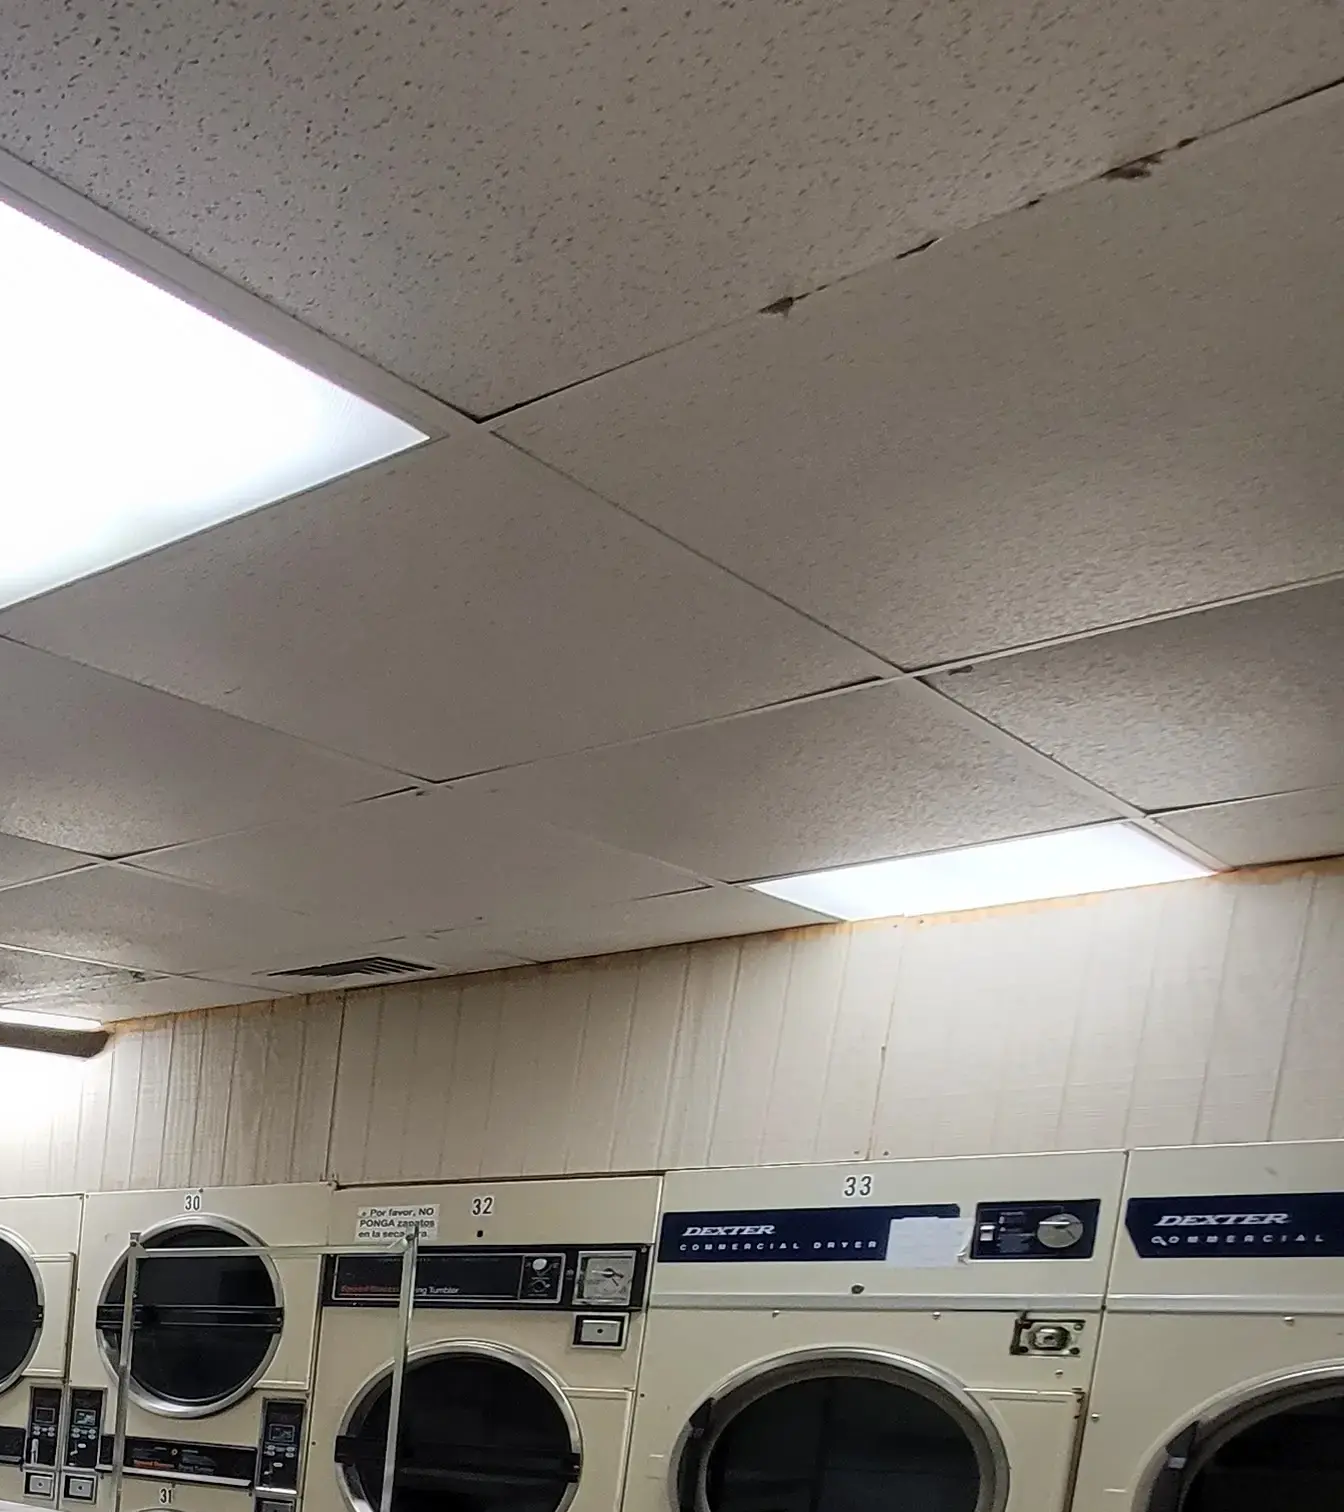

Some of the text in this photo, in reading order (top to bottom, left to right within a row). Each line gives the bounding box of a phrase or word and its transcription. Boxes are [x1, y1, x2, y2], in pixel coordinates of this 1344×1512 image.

[844, 1175, 872, 1197] 33
[185, 1195, 200, 1211] 30
[472, 1197, 493, 1215] 32
[370, 1209, 387, 1217] Por
[418, 1207, 434, 1216] NO
[359, 1219, 395, 1228] PONGA
[1154, 1213, 1292, 1226] DEXTER
[372, 1230, 381, 1238] la
[682, 1225, 776, 1236] DEXTER
[679, 1240, 877, 1251] COMMERCIAL DRYER
[1151, 1234, 1324, 1246] COMMERCIAL
[429, 1286, 460, 1294] Tumbler
[160, 1488, 172, 1503] 31
